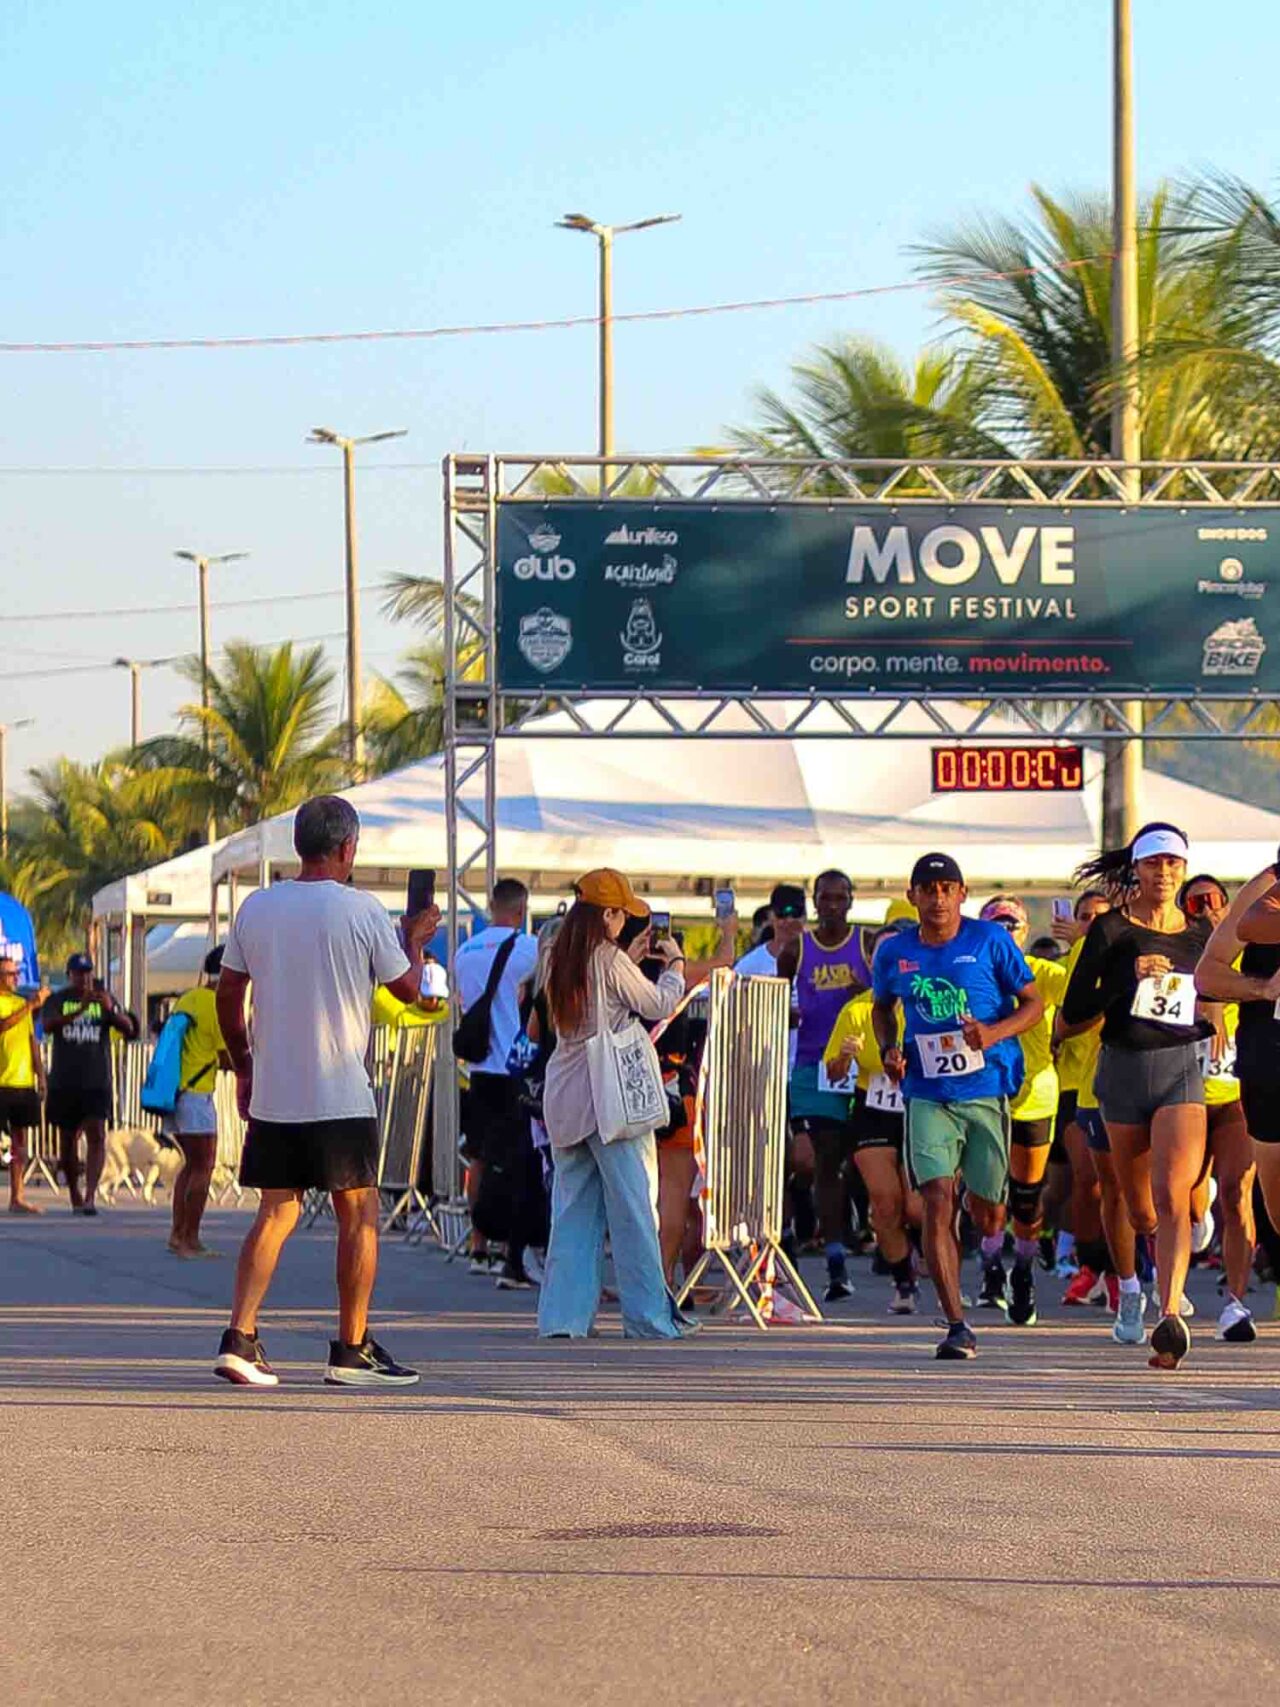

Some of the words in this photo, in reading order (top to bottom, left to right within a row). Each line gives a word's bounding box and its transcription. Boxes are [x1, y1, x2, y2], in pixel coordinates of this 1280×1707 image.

[846, 525, 1076, 585] MOVE
[513, 554, 577, 581] dub
[845, 596, 936, 619] SPORT
[950, 596, 1077, 619] FESTIVAL
[810, 654, 881, 677] corpo.
[886, 652, 963, 674] mente.
[969, 652, 1111, 674] movimento.
[1207, 652, 1257, 667] BIKE
[1151, 996, 1181, 1019] 34
[935, 1053, 967, 1074] 20
